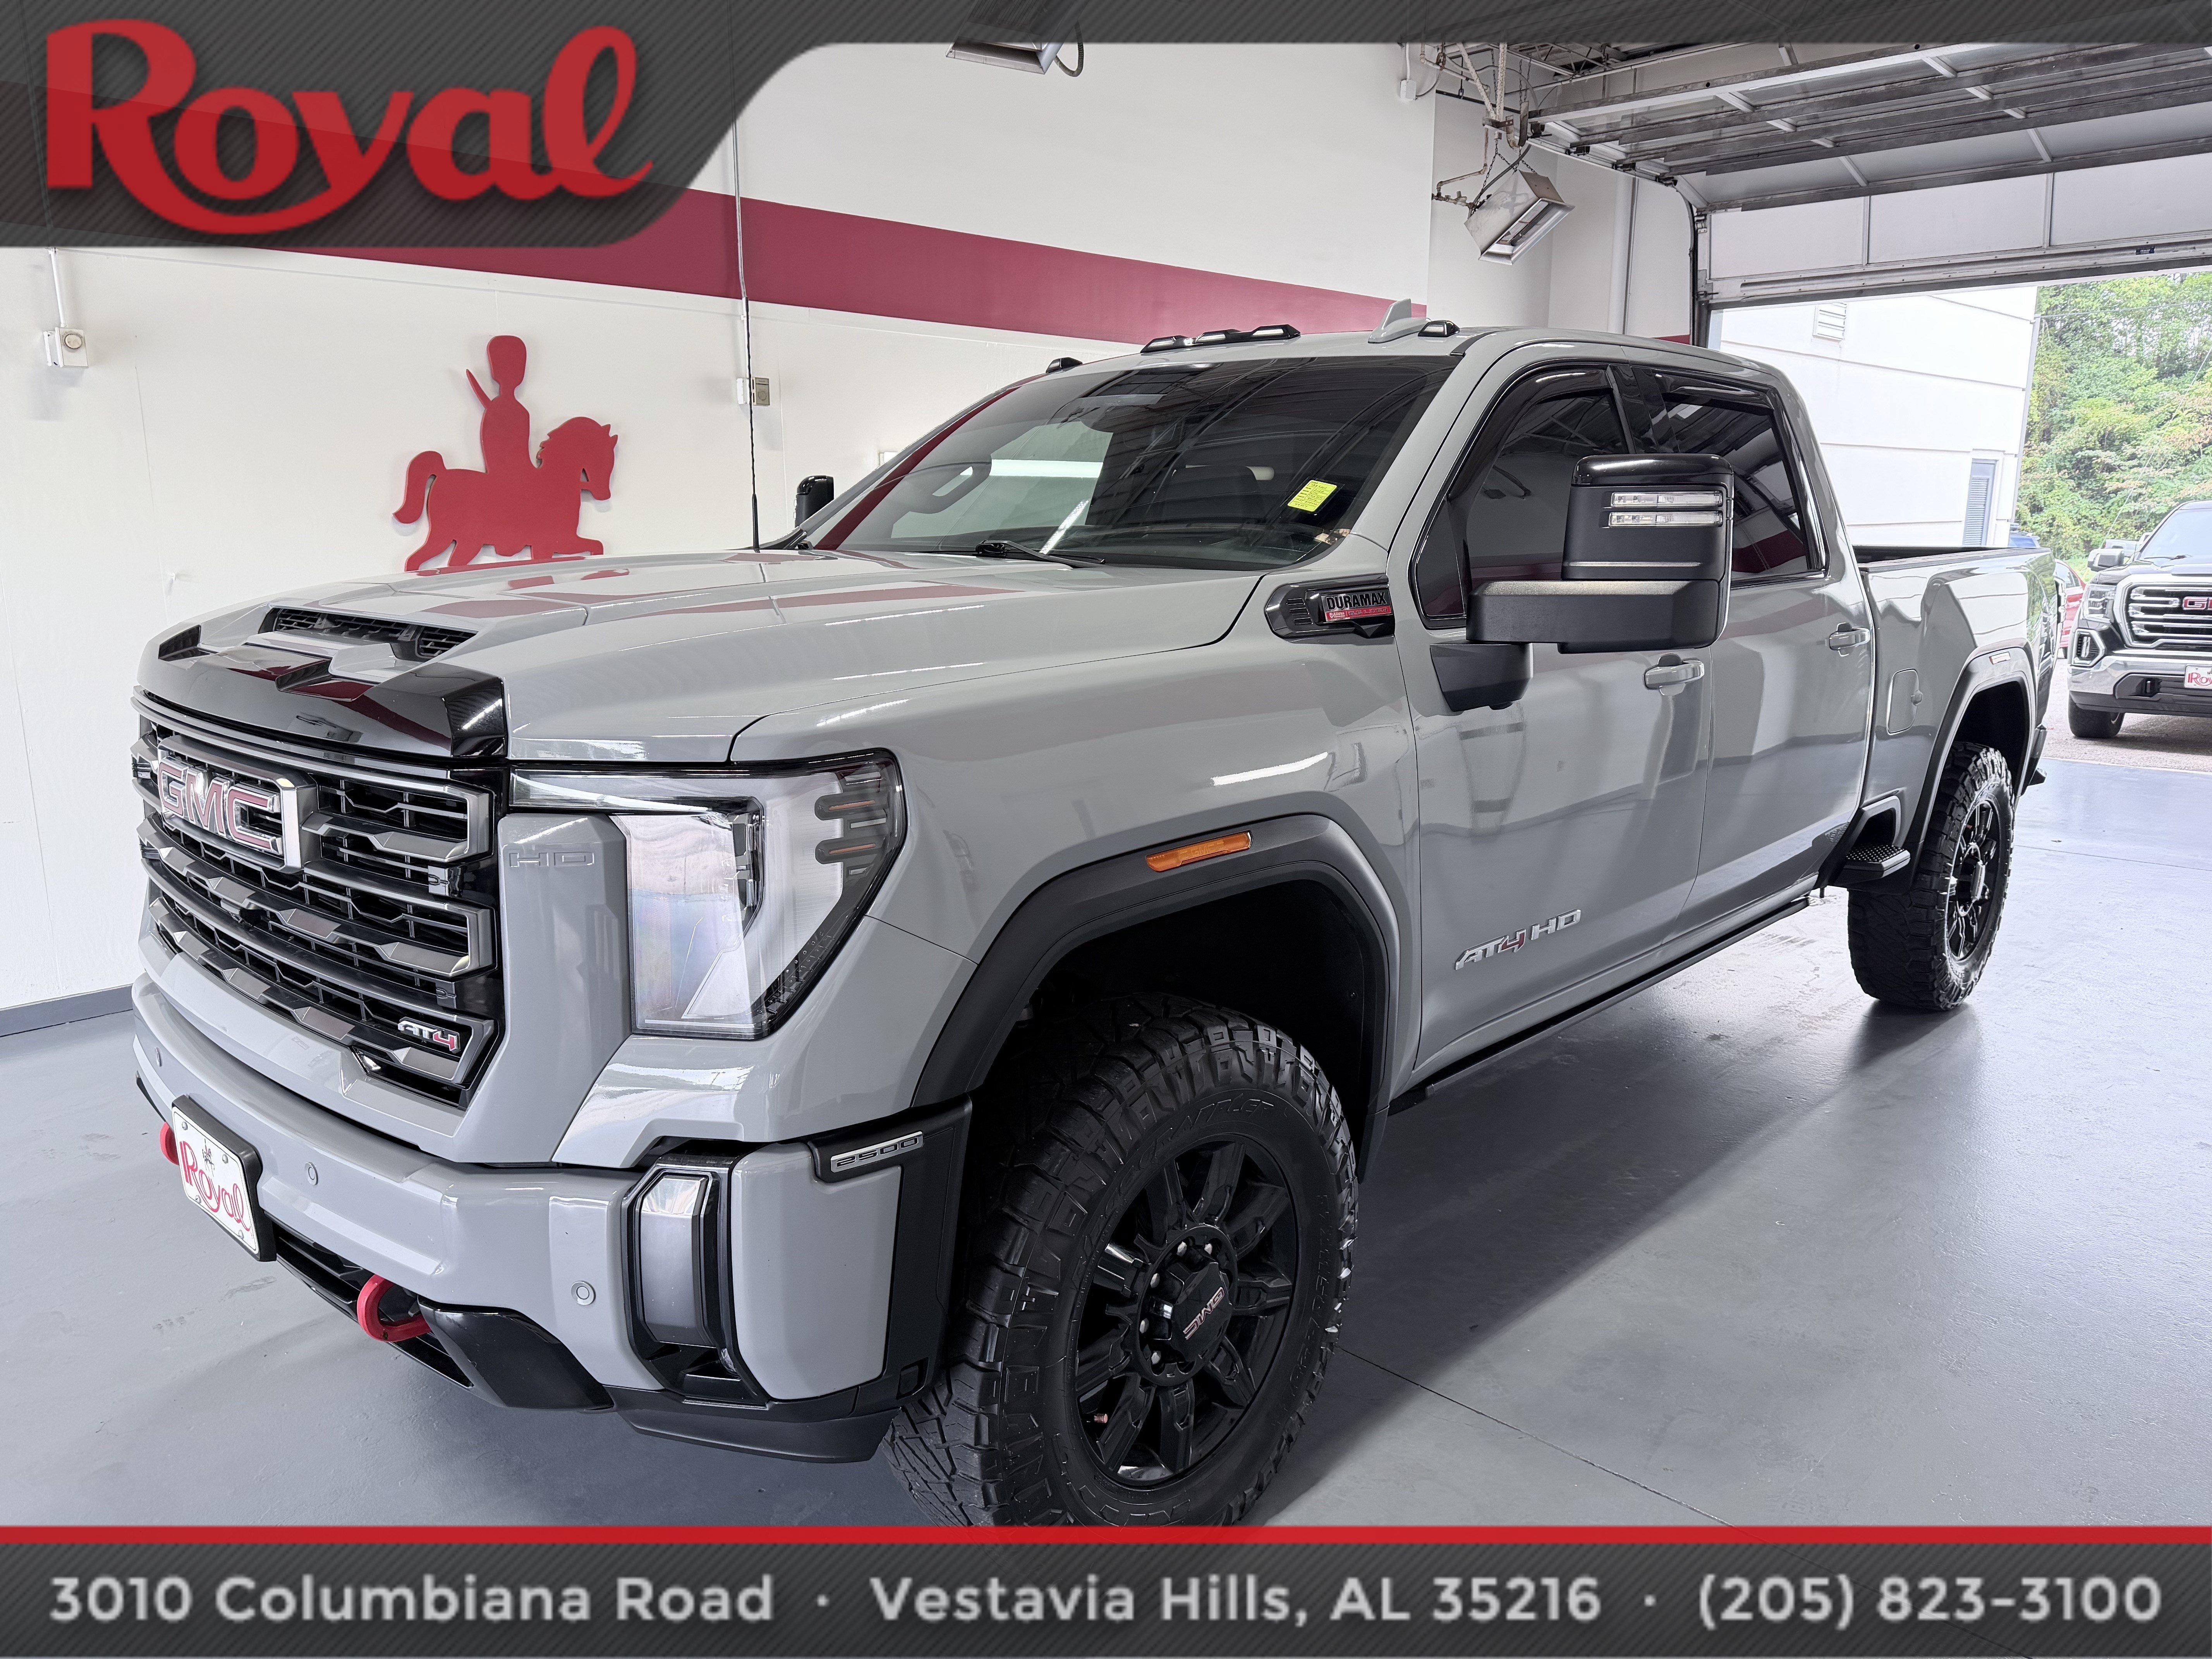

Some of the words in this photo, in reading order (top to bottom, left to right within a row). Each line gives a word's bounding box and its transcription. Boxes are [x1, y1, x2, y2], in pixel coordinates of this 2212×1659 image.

[1326, 592, 1387, 610] DURAMAX
[157, 756, 283, 856] GMC
[509, 851, 594, 867] HD
[1453, 928, 1526, 970] AT4
[1530, 908, 1582, 941] HD
[397, 1020, 459, 1052] AT4
[836, 1137, 919, 1167] 2500
[179, 1140, 251, 1231] Royal
[1183, 1286, 1225, 1340] GMC
